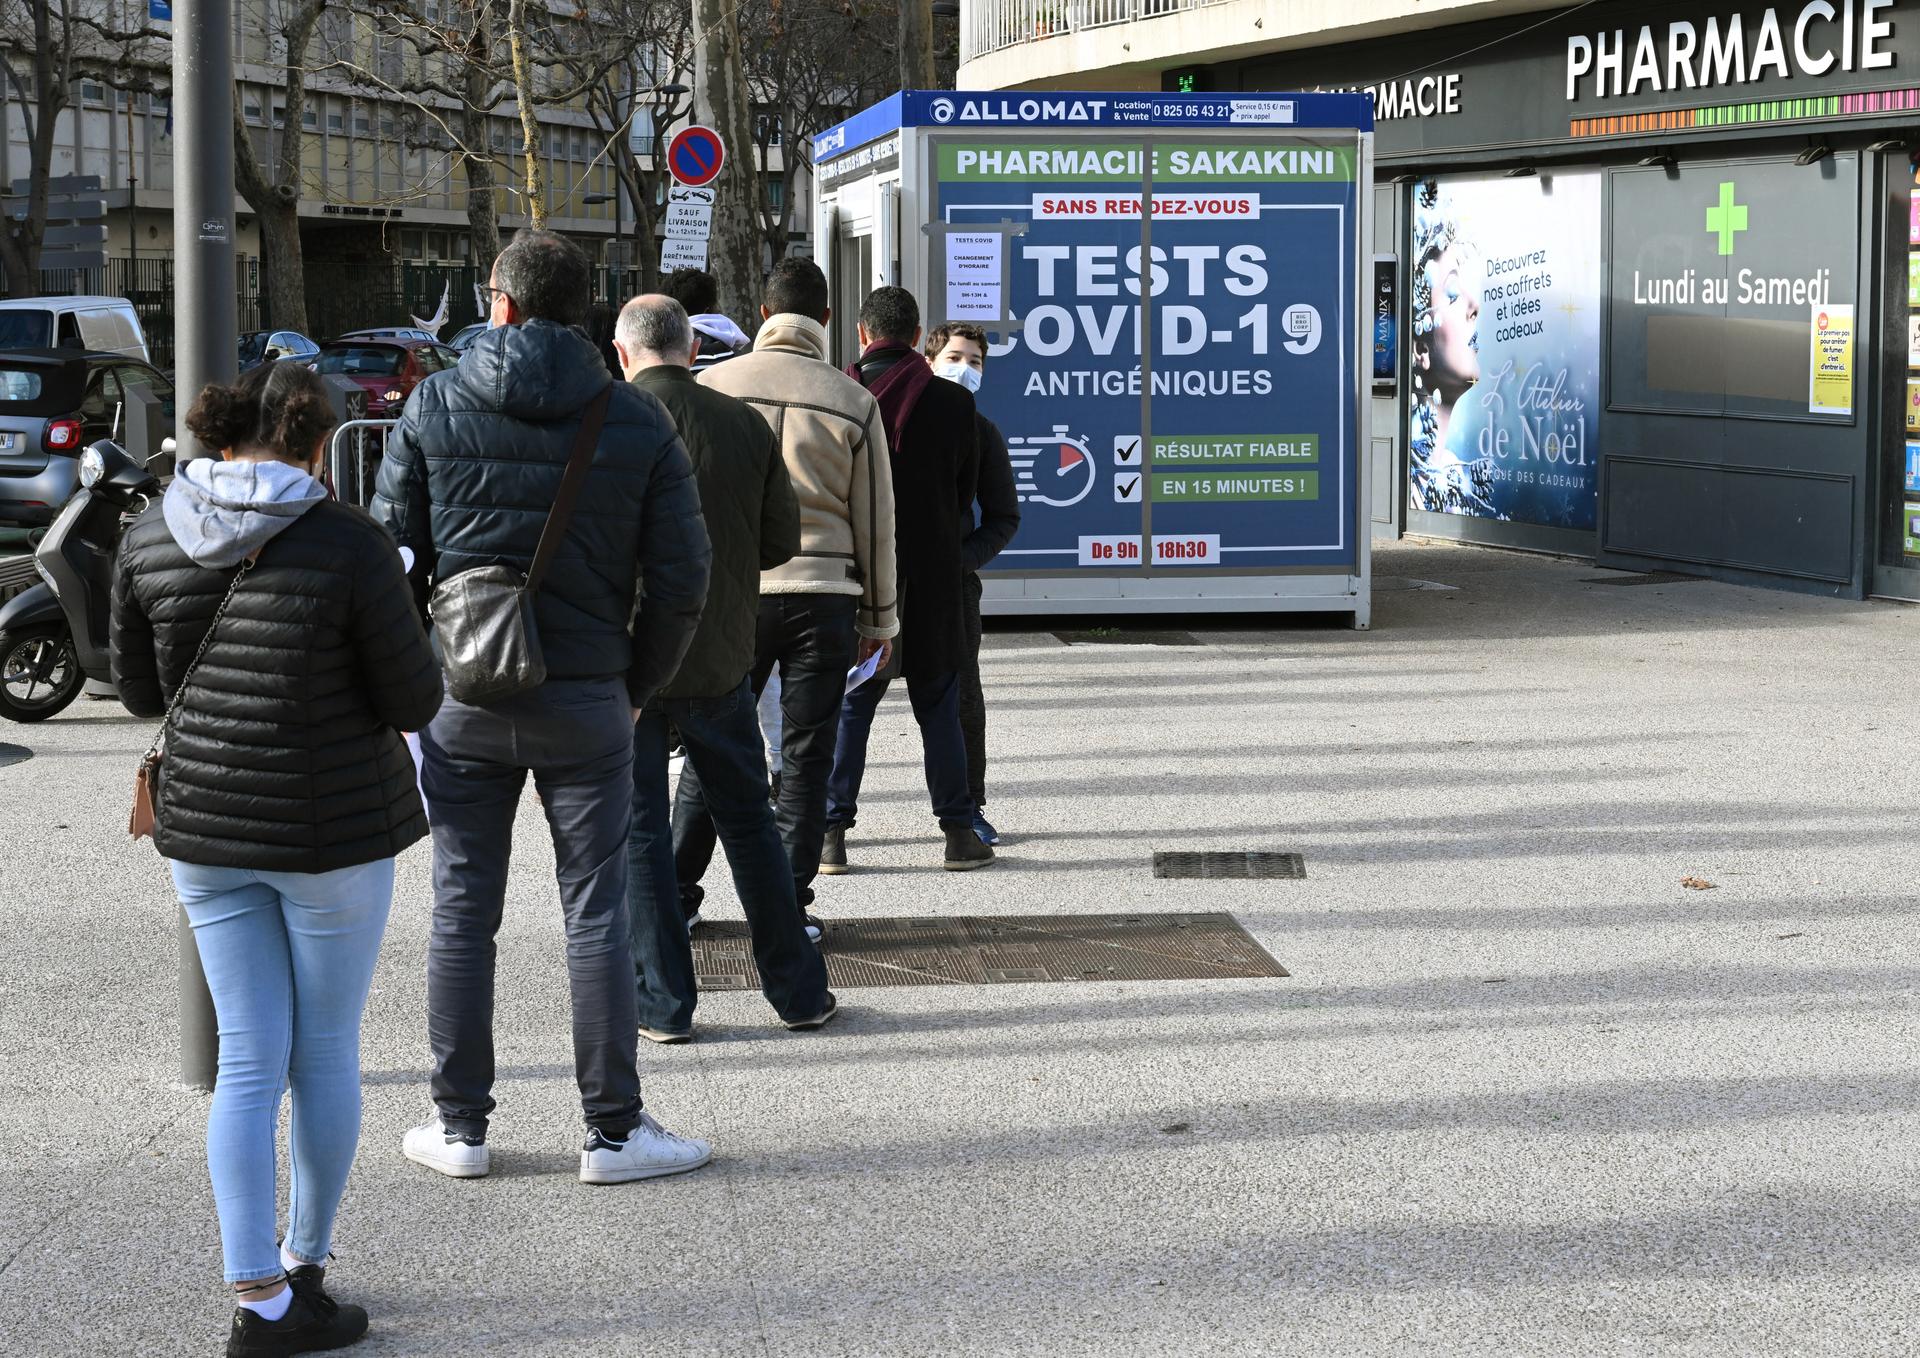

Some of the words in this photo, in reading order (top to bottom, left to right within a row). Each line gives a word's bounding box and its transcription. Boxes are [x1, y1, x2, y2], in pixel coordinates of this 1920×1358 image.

[1566, 0, 1894, 100] PHARMACIE
[1114, 101, 1152, 109] Location
[1320, 73, 1460, 120] RMACIE
[959, 101, 1106, 120] ALLOMAT
[1114, 112, 1121, 120] &
[1123, 112, 1149, 120] Vente
[1153, 105, 1161, 116] 0
[1163, 105, 1182, 116] 825
[1185, 105, 1198, 117] 05
[1201, 105, 1214, 117] 43
[1217, 105, 1229, 117] 21
[1253, 112, 1270, 120] appel
[1257, 103, 1271, 111] 0,15
[957, 150, 1159, 175] PHARMACIE
[1169, 150, 1334, 175] SAKAKINI
[679, 208, 700, 216] SAUF
[1042, 200, 1097, 214] SANS
[1105, 199, 1250, 215] RENDEZ-VOUS
[668, 218, 708, 227] LIVRAISON
[663, 252, 682, 260] ARRÊT
[1486, 249, 1546, 277] Découvrez
[1023, 244, 1269, 297] TESTS
[1484, 287, 1504, 303] nos
[1506, 272, 1552, 297] coffrets
[1634, 268, 1695, 305] Lundi
[1701, 277, 1729, 305] au
[1737, 267, 1830, 306] Samedi
[1496, 304, 1508, 321] et
[1510, 297, 1541, 318] idées
[1379, 298, 1388, 341] MANIX
[1496, 319, 1544, 343] cadeaux
[1823, 329, 1841, 337] premier
[1831, 337, 1847, 345] arrêter
[1023, 365, 1273, 397] ANTIGÉNIQUES
[1478, 410, 1509, 459] de
[1518, 414, 1588, 466] Noël
[1155, 441, 1244, 458] RÉSULTAT
[1249, 442, 1312, 457] FIABLE
[1162, 480, 1187, 494] EN
[1192, 479, 1211, 494] 15
[1216, 478, 1295, 494] MINUTES
[1300, 478, 1305, 493] !
[1517, 471, 1535, 484] DES
[1539, 473, 1585, 489] CADEAUX
[1092, 542, 1113, 559] De
[1117, 541, 1139, 559] 9h
[1156, 540, 1207, 559] 18h30
